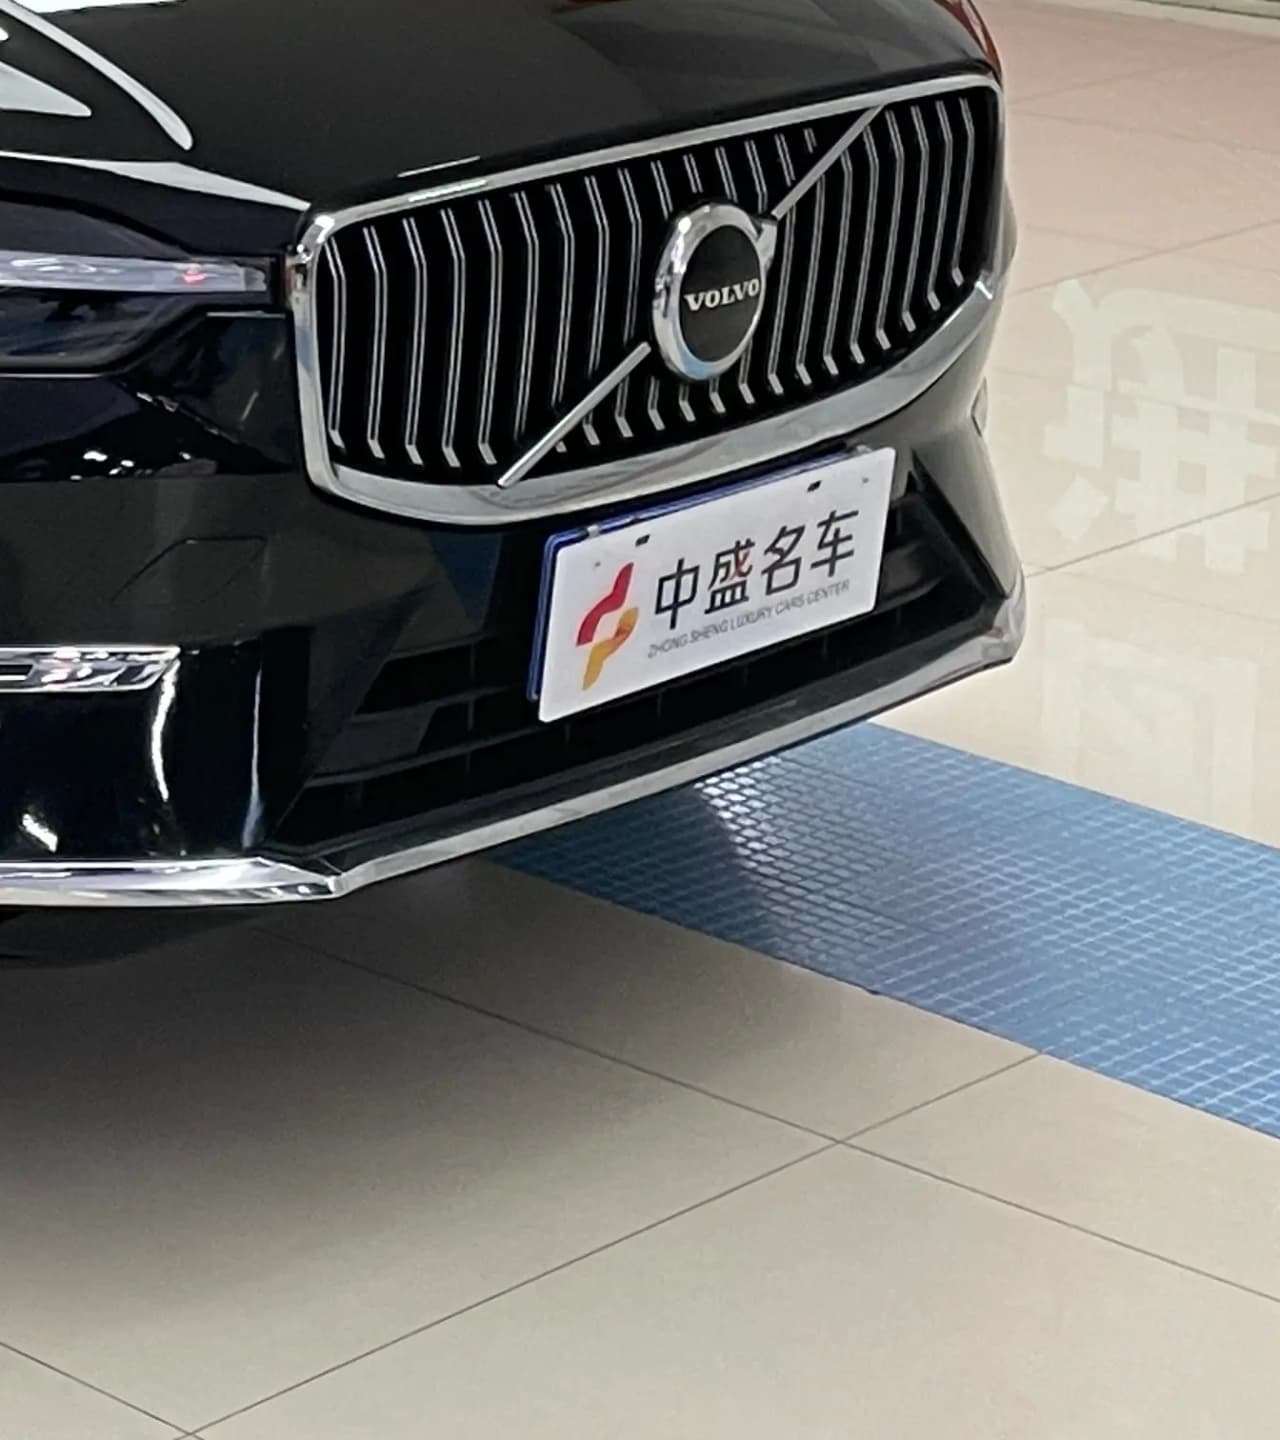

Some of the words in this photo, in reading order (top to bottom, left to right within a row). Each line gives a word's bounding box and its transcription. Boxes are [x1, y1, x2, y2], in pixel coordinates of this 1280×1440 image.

[683, 279, 760, 311] VOLVO
[654, 510, 860, 630] 中盛名车
[648, 633, 689, 658] ZHONG
[691, 618, 728, 643] SHENG
[776, 595, 805, 616] CARS
[807, 579, 850, 605] CENTER
